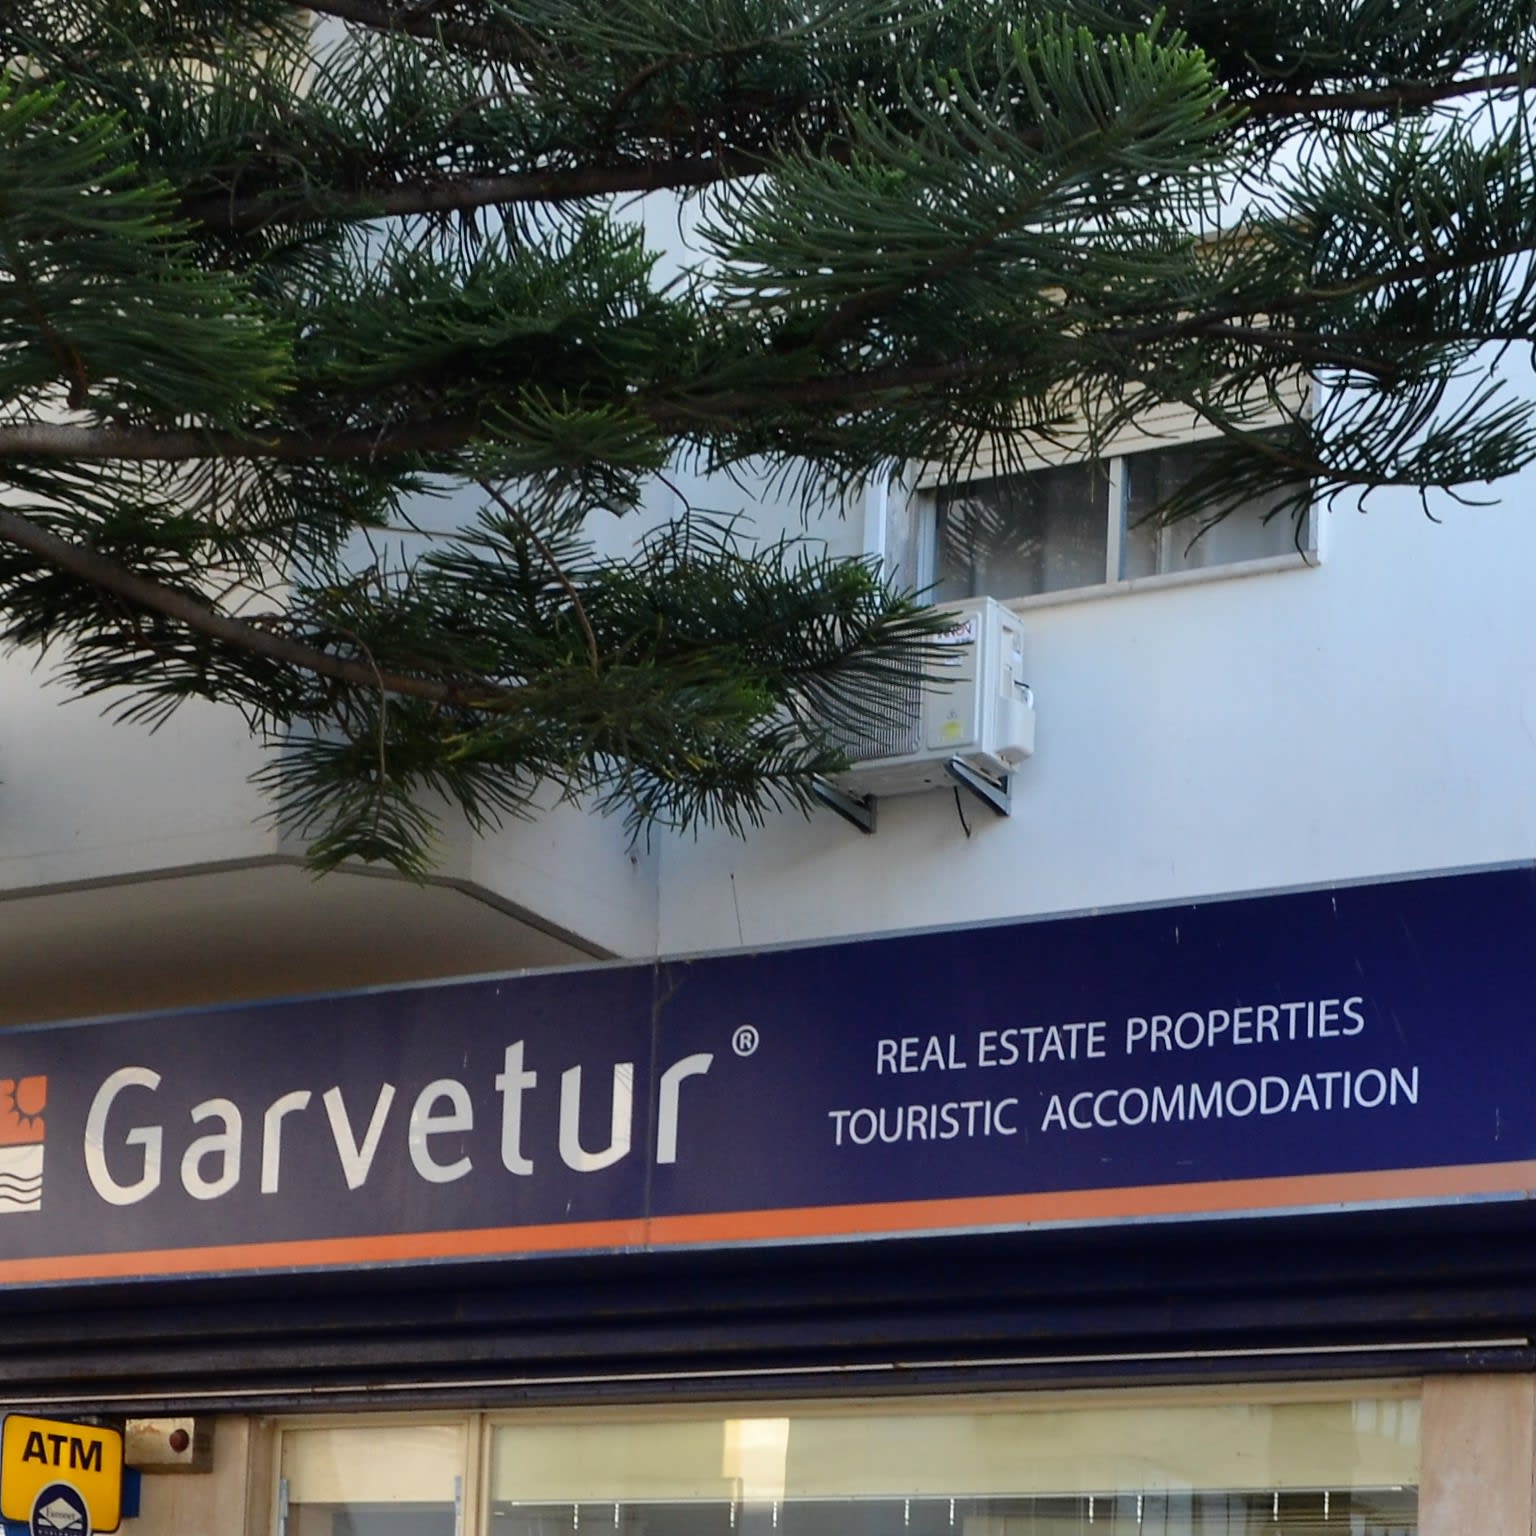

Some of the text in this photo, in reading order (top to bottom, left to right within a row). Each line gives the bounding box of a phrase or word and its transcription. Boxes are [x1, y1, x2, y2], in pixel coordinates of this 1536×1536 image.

[875, 996, 1366, 1075] REAL ESTATE PROPERTIES
[84, 1039, 714, 1206] Garvetur
[829, 1065, 1420, 1147] TOURISTIC ACCOMMODATION
[21, 1431, 103, 1473] ATM
